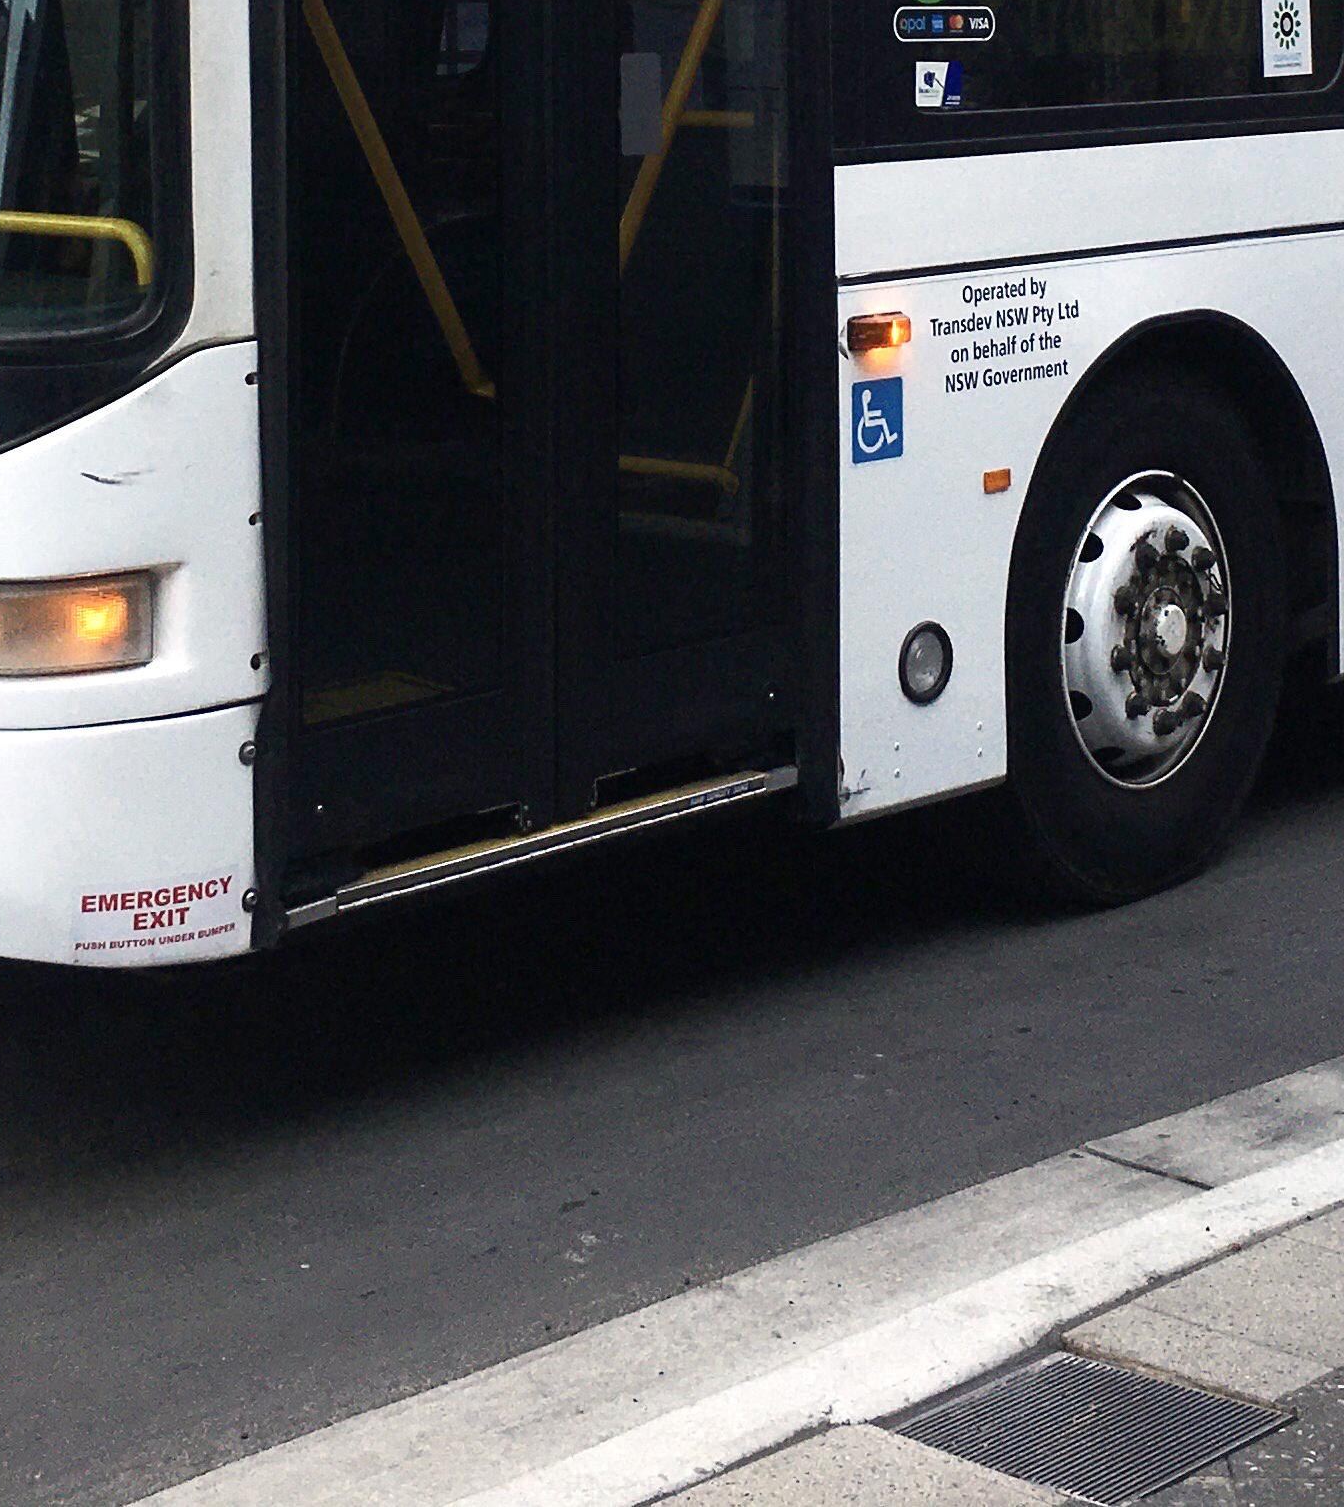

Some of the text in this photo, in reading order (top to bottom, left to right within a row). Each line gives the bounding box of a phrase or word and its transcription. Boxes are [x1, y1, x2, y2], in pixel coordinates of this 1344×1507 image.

[968, 17, 990, 30] VISA
[962, 276, 1048, 307] Operated by
[929, 299, 1080, 337] Transdev NSW Pty Ltd
[950, 331, 1062, 364] on behalf of the
[945, 359, 1069, 394] NSW Government
[81, 874, 234, 913] EMERGENCY
[132, 906, 191, 932] EXIT
[74, 921, 237, 952] PUSH BUTTON UNDER BUMPER
